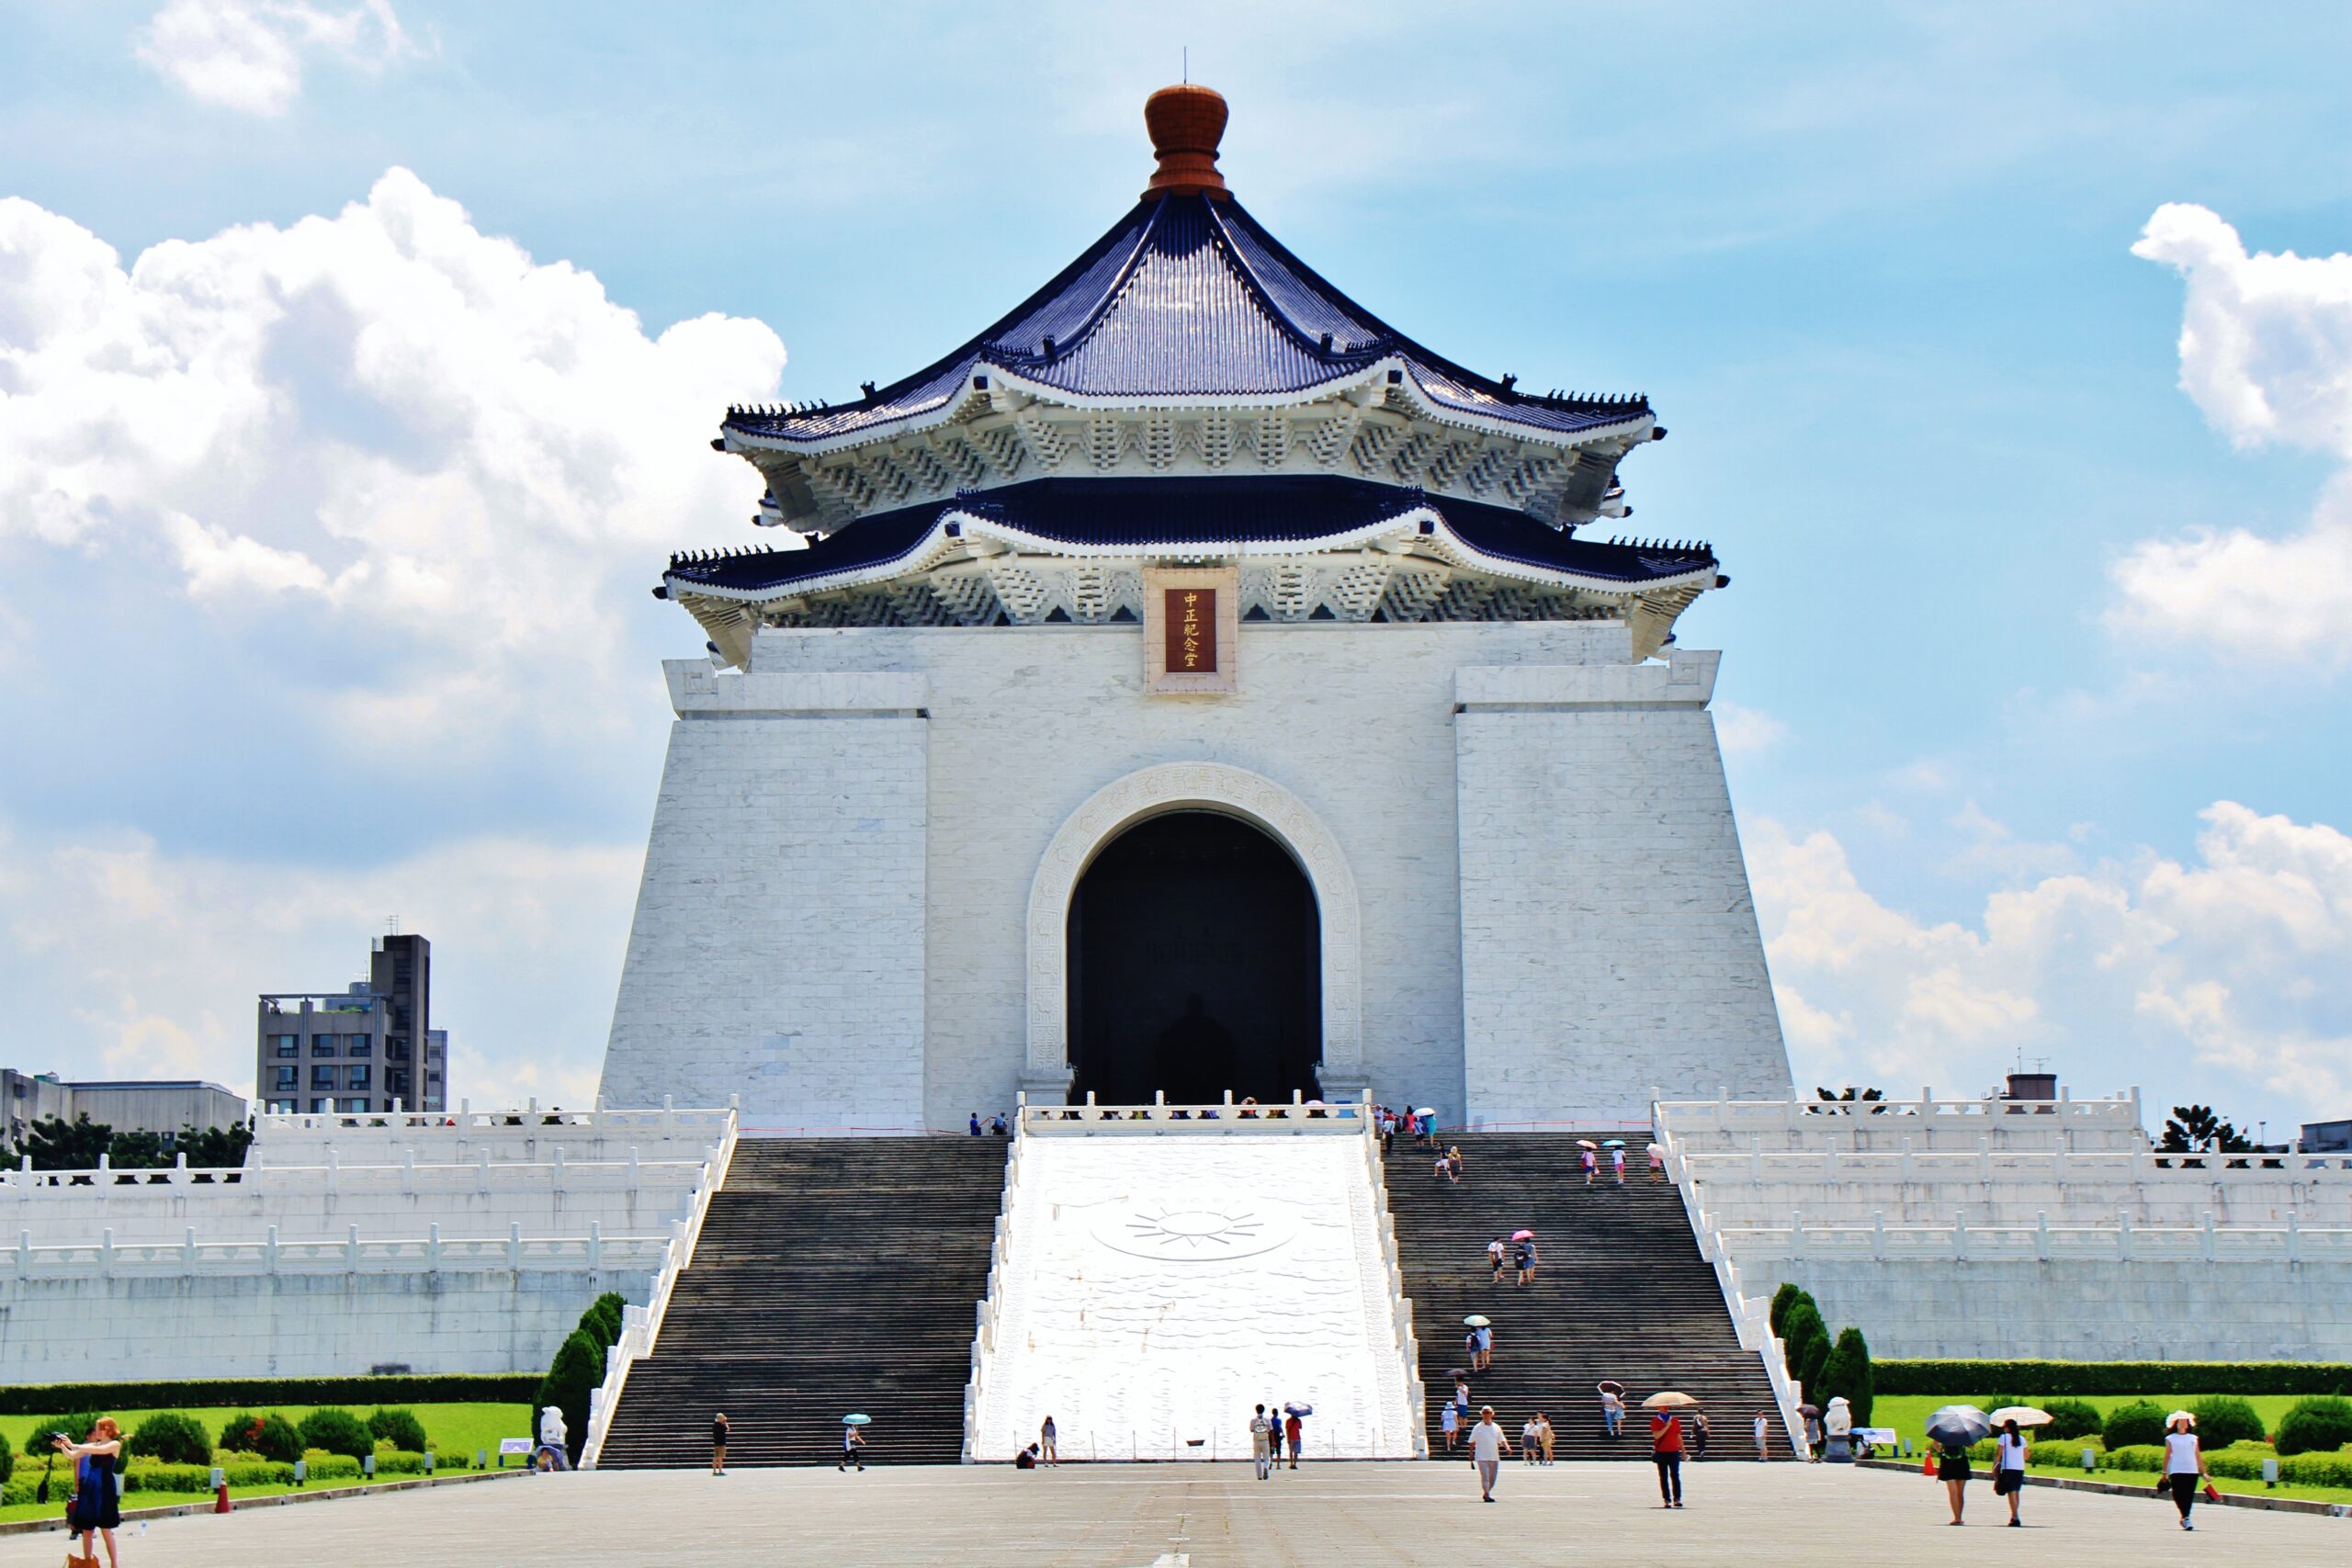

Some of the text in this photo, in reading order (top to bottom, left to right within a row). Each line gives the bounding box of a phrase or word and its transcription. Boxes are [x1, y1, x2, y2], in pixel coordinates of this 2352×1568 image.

[1183, 592, 1199, 667] 中正紀念堂
